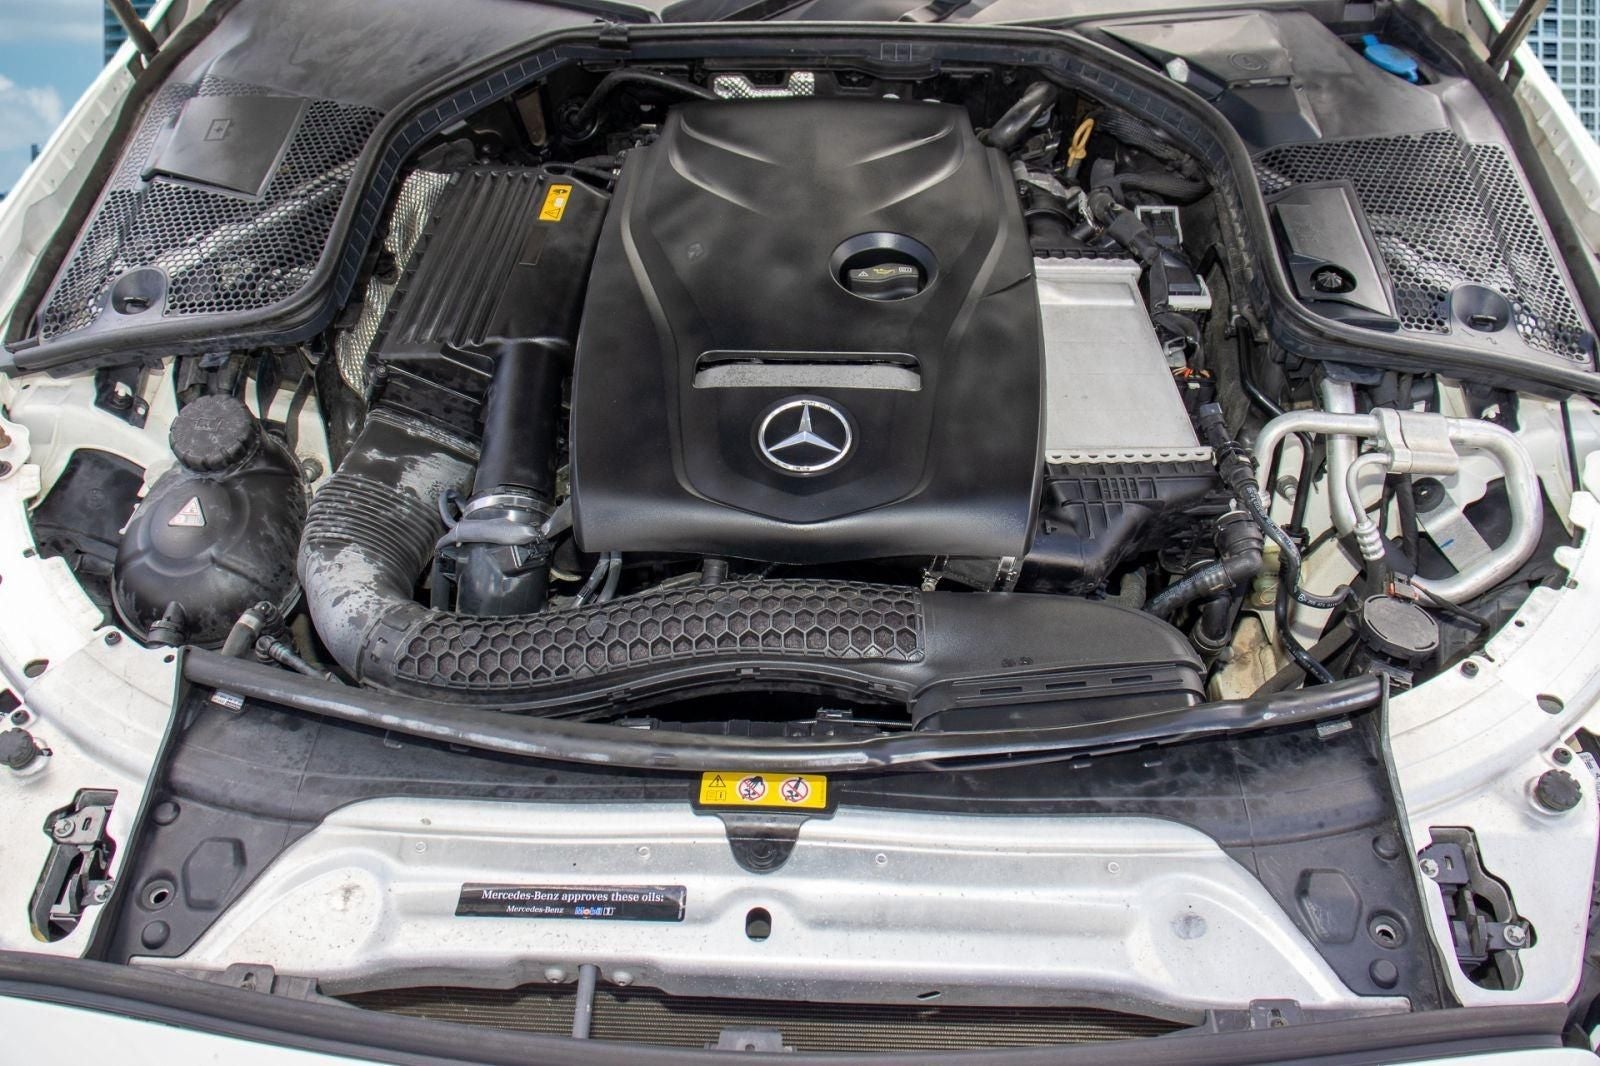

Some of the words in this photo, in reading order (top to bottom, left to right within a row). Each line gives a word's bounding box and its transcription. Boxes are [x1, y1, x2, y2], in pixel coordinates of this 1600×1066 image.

[481, 889, 560, 901] Mercedes-Benz
[561, 891, 608, 903] approves
[611, 891, 640, 902] these
[641, 892, 665, 902] oils:
[505, 904, 564, 914] Mercedes-Benz
